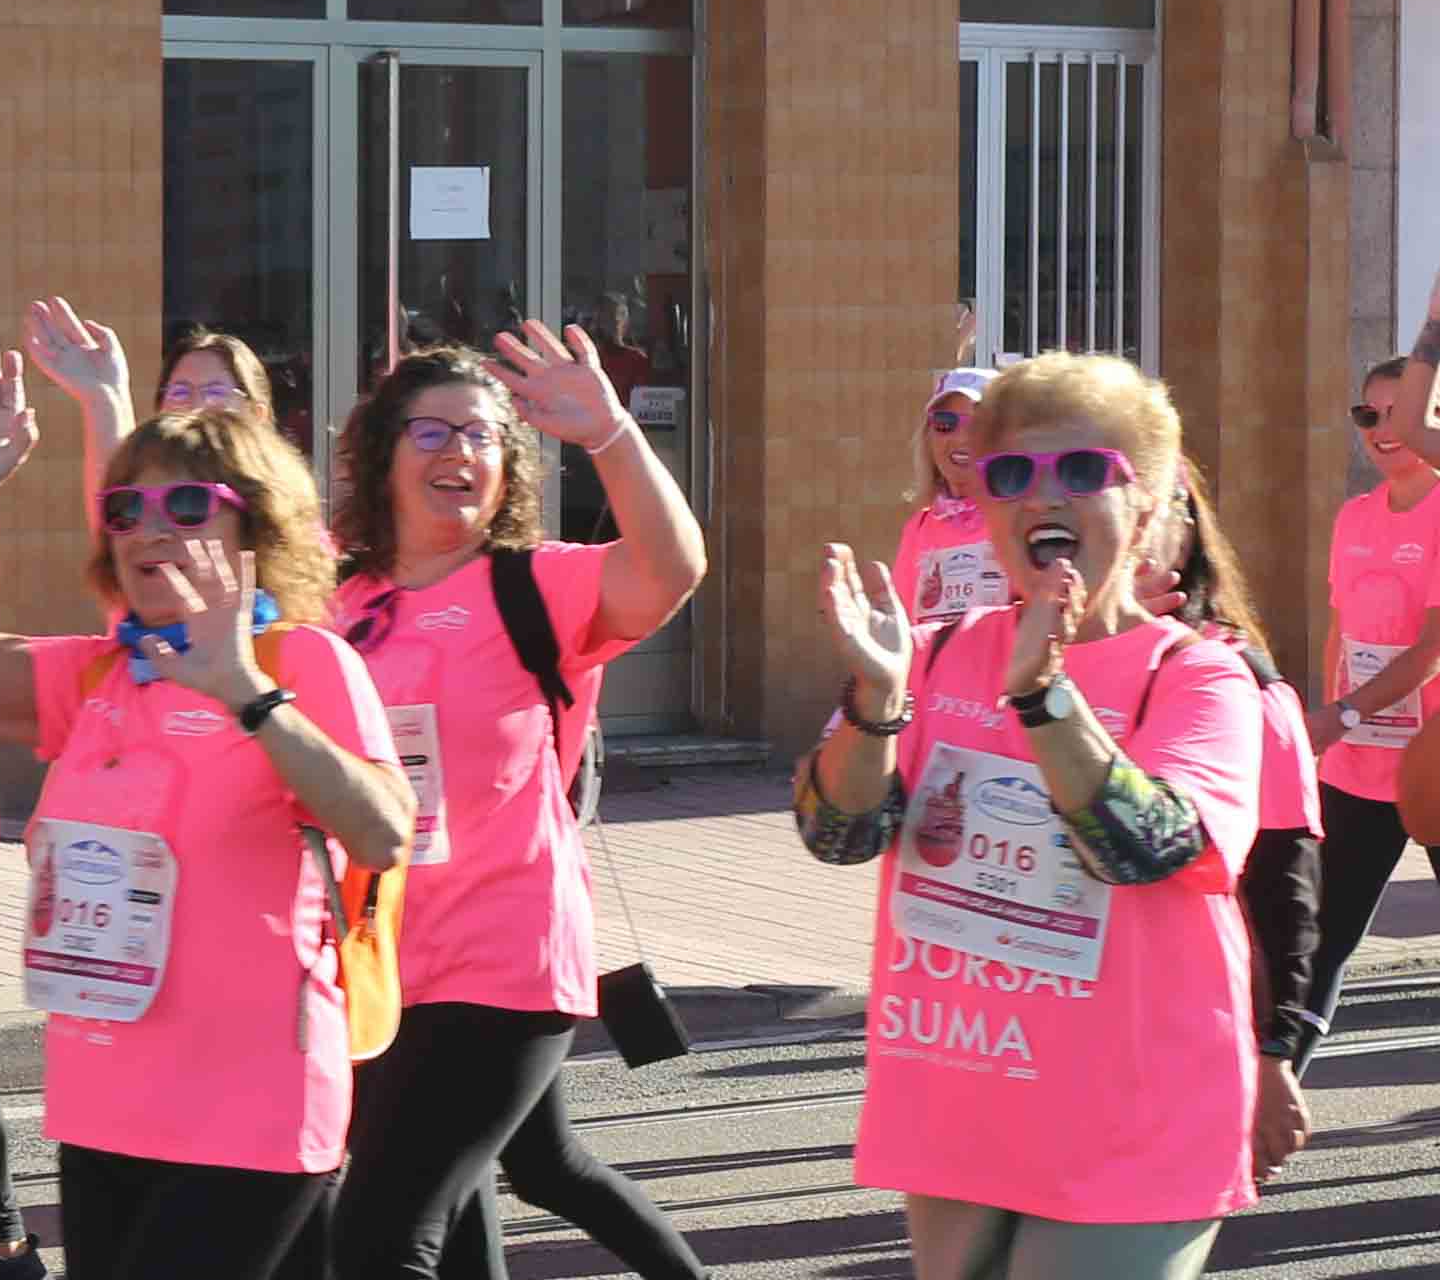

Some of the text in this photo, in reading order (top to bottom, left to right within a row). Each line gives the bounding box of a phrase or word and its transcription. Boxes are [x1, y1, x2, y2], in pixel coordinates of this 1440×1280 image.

[970, 832, 1036, 873] 016
[57, 896, 111, 930] 016
[878, 995, 1033, 1061] SUMA
